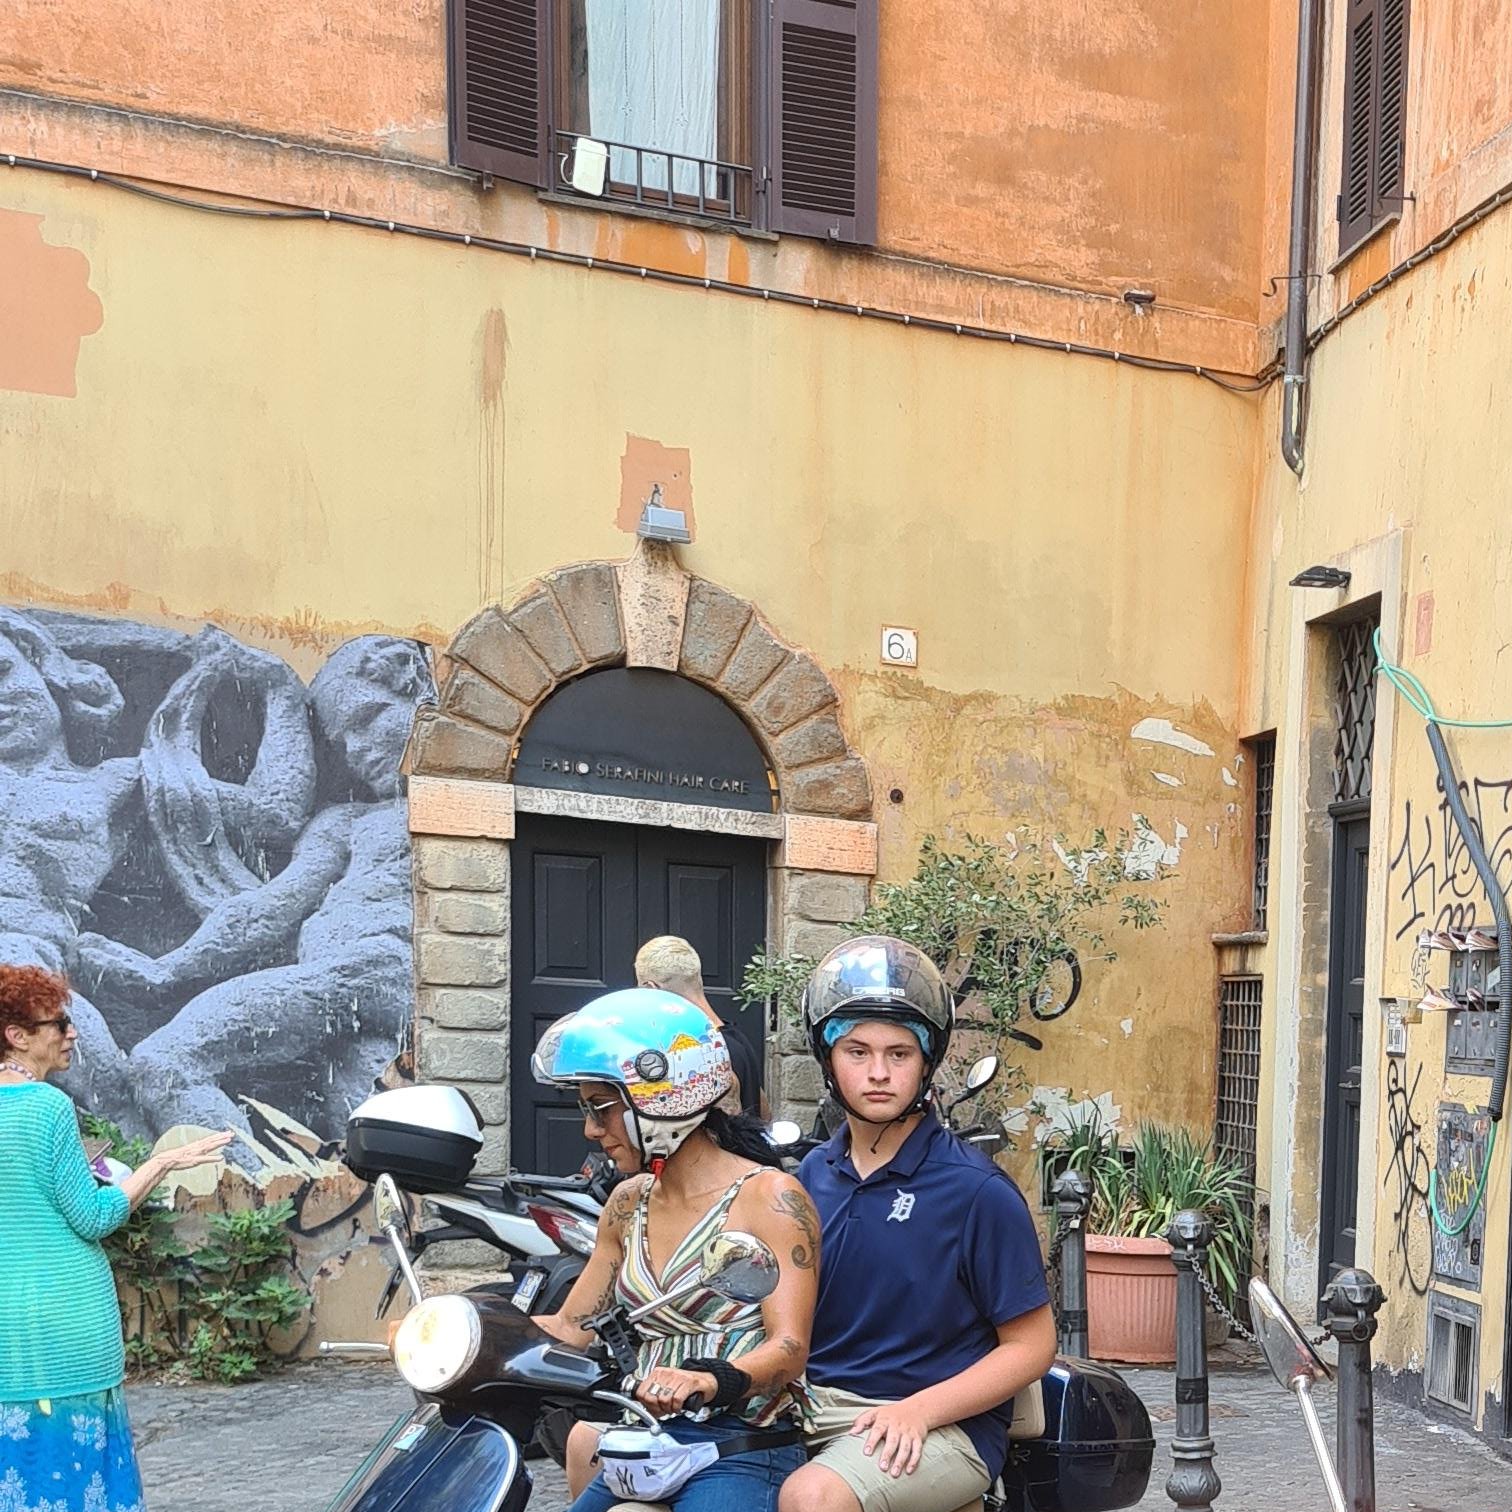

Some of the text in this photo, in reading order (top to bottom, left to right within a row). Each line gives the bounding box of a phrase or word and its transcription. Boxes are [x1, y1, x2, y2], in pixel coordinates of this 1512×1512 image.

[541, 757, 750, 794] FABIO SERAFINI HAIR CARE
